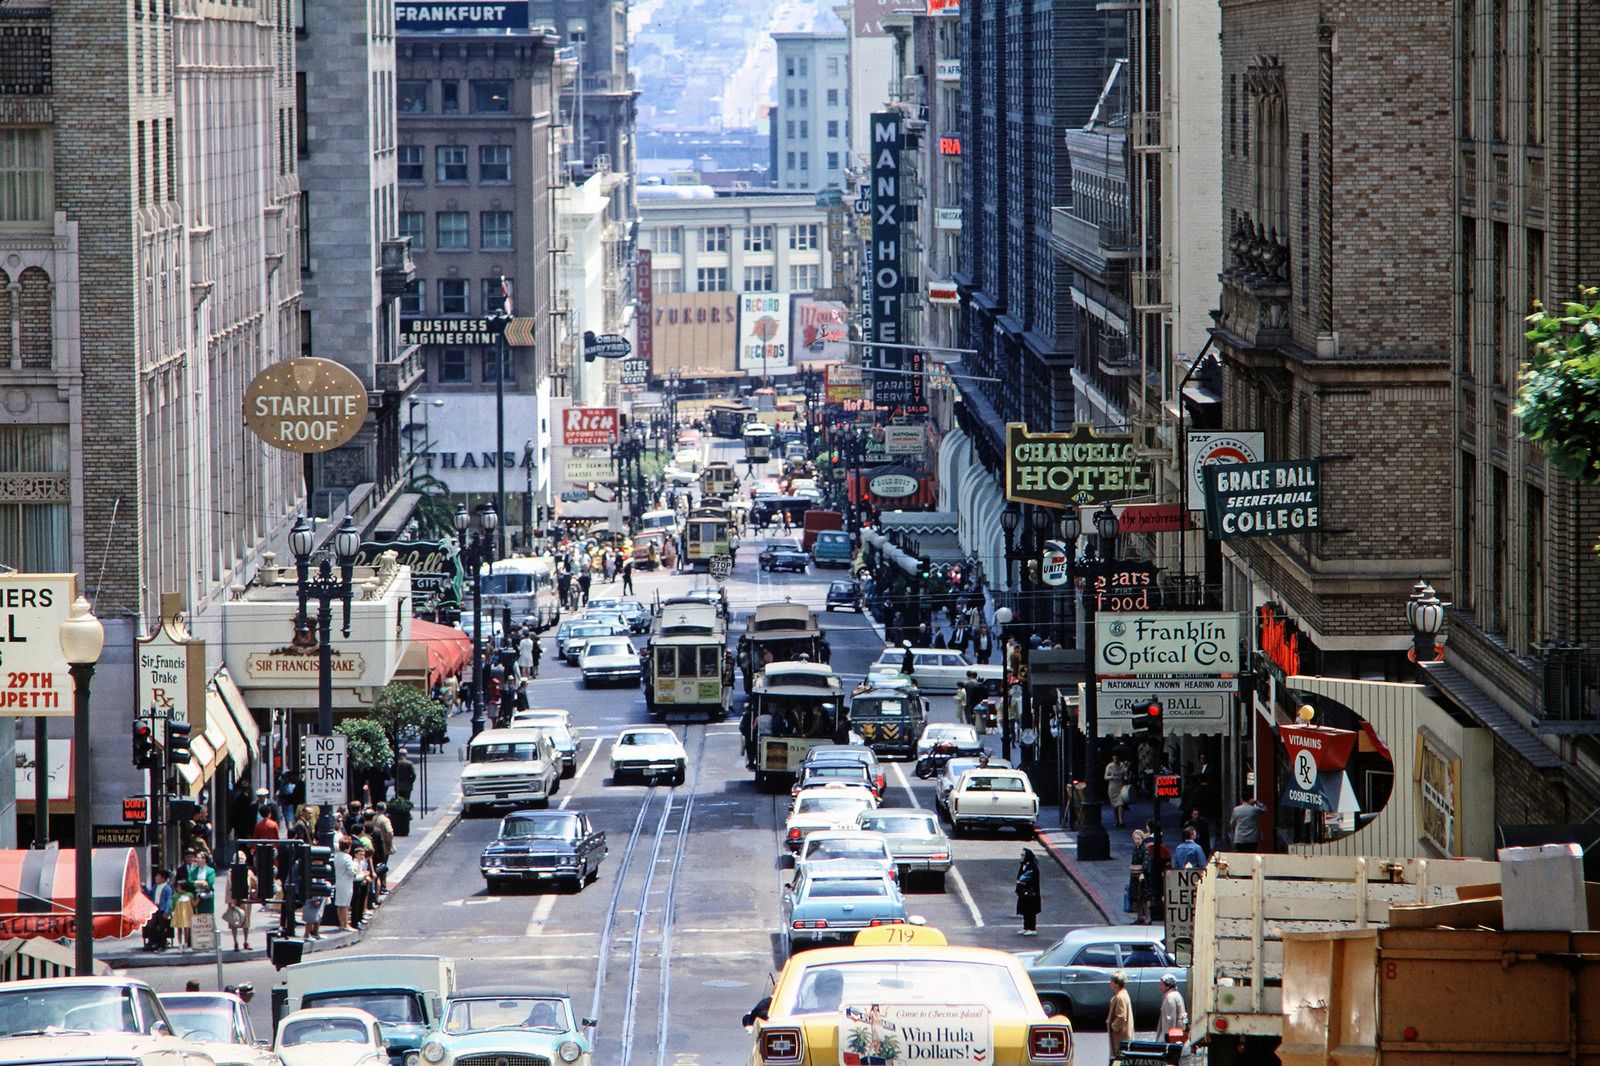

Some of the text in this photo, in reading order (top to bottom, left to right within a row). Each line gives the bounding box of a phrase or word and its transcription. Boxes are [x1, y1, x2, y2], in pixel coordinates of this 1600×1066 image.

[395, 6, 506, 21] FRANKFURT
[875, 122, 898, 369] MANX HOTEL
[745, 298, 779, 312] RECORD
[412, 320, 488, 331] BUSINESS
[744, 345, 785, 359] RECORDS
[876, 381, 912, 390] GARAG
[255, 395, 357, 417] STARLITE
[280, 420, 339, 441] ROOF
[1190, 435, 1211, 443] FLY
[1016, 466, 1150, 490] HOTEL
[1217, 470, 1270, 492] GRACE
[1276, 467, 1316, 488] BALL
[1226, 492, 1313, 508] SECRETARIAL
[1222, 507, 1318, 534] COLLEGE
[1043, 563, 1066, 573] UNITE
[0, 589, 53, 607] ERS
[1134, 617, 1226, 644] Franklin
[141, 655, 186, 669] Sir Francis
[1103, 641, 1233, 670] Optical Co.
[255, 660, 355, 672] SIR FRANCIS RAKE
[8, 672, 52, 689] 29TH
[151, 670, 178, 684] Drake
[1107, 681, 1233, 689] NATIONALLY KNOWN HEARING AIDS
[1167, 698, 1202, 710] BALL
[316, 739, 335, 751] NO
[1288, 734, 1322, 750] VITAMINS
[308, 753, 342, 765] LEFT
[308, 768, 344, 780] TURN
[1158, 787, 1179, 796] WALK
[1289, 789, 1323, 806] COSMETICS
[125, 810, 146, 819] WALK
[97, 834, 141, 843] PHARMACY
[1178, 871, 1201, 887] NO
[887, 927, 915, 944] 719
[1386, 962, 1397, 979] 8
[896, 1010, 918, 1018] Come
[928, 1010, 958, 1019] Chevron
[901, 1027, 974, 1042] Win Hula
[907, 1044, 970, 1060] Dollars!
